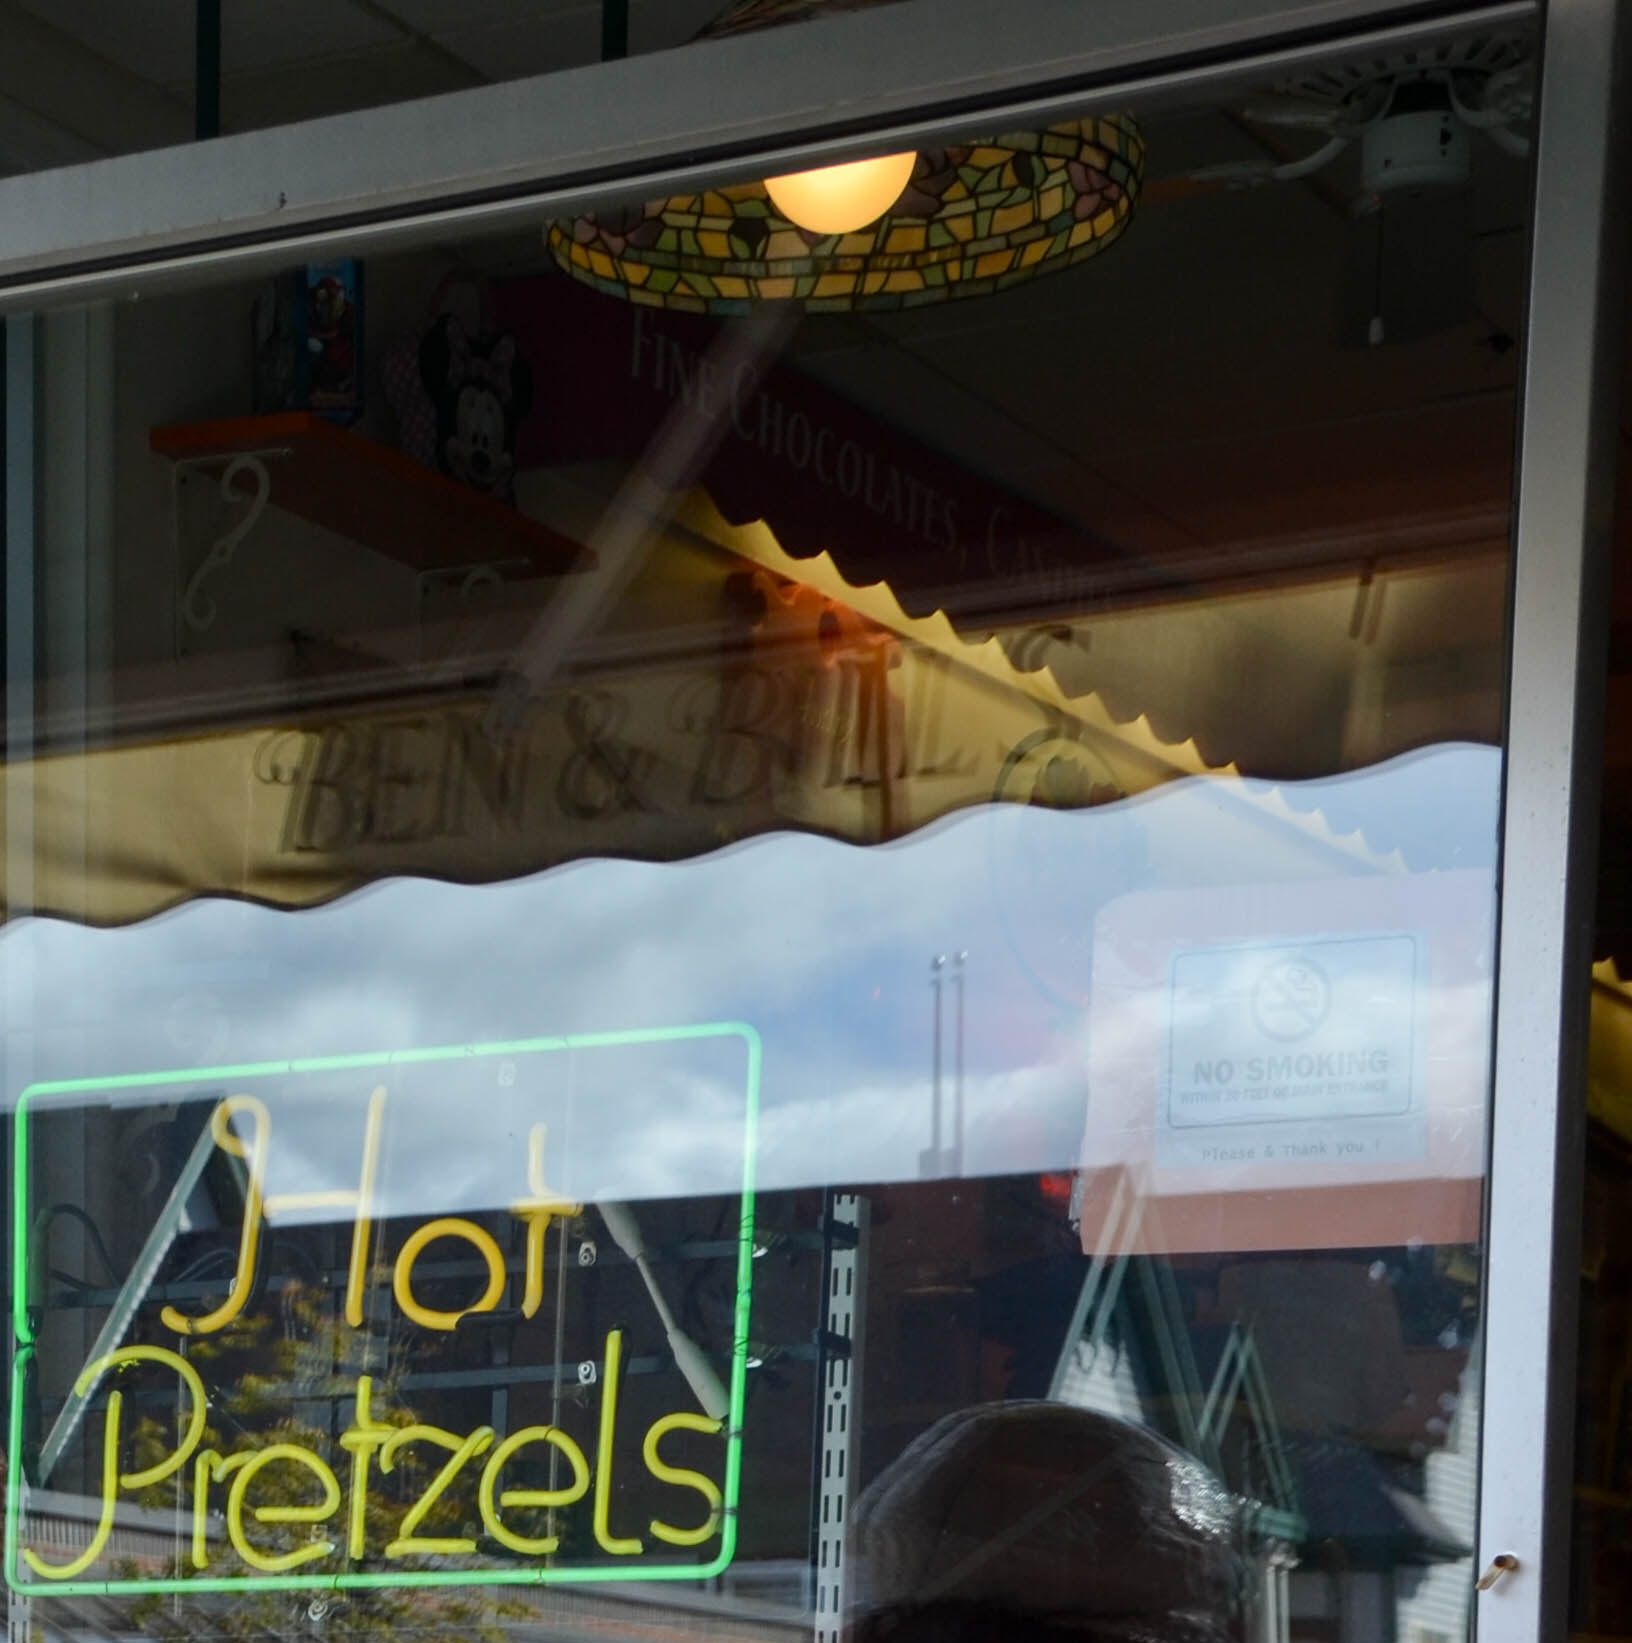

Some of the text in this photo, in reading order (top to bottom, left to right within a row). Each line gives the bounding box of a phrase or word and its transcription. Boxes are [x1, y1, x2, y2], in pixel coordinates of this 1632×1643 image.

[252, 708, 523, 852] BEN
[549, 685, 658, 820] &
[1193, 1048, 1390, 1085] NO SMOKING
[163, 1085, 582, 1336] Hot
[1201, 1145, 1256, 1161] Please
[1264, 1144, 1275, 1158] &
[1284, 1140, 1328, 1157] Thank
[1336, 1140, 1365, 1157] you
[24, 1329, 727, 1580] Pretzels
